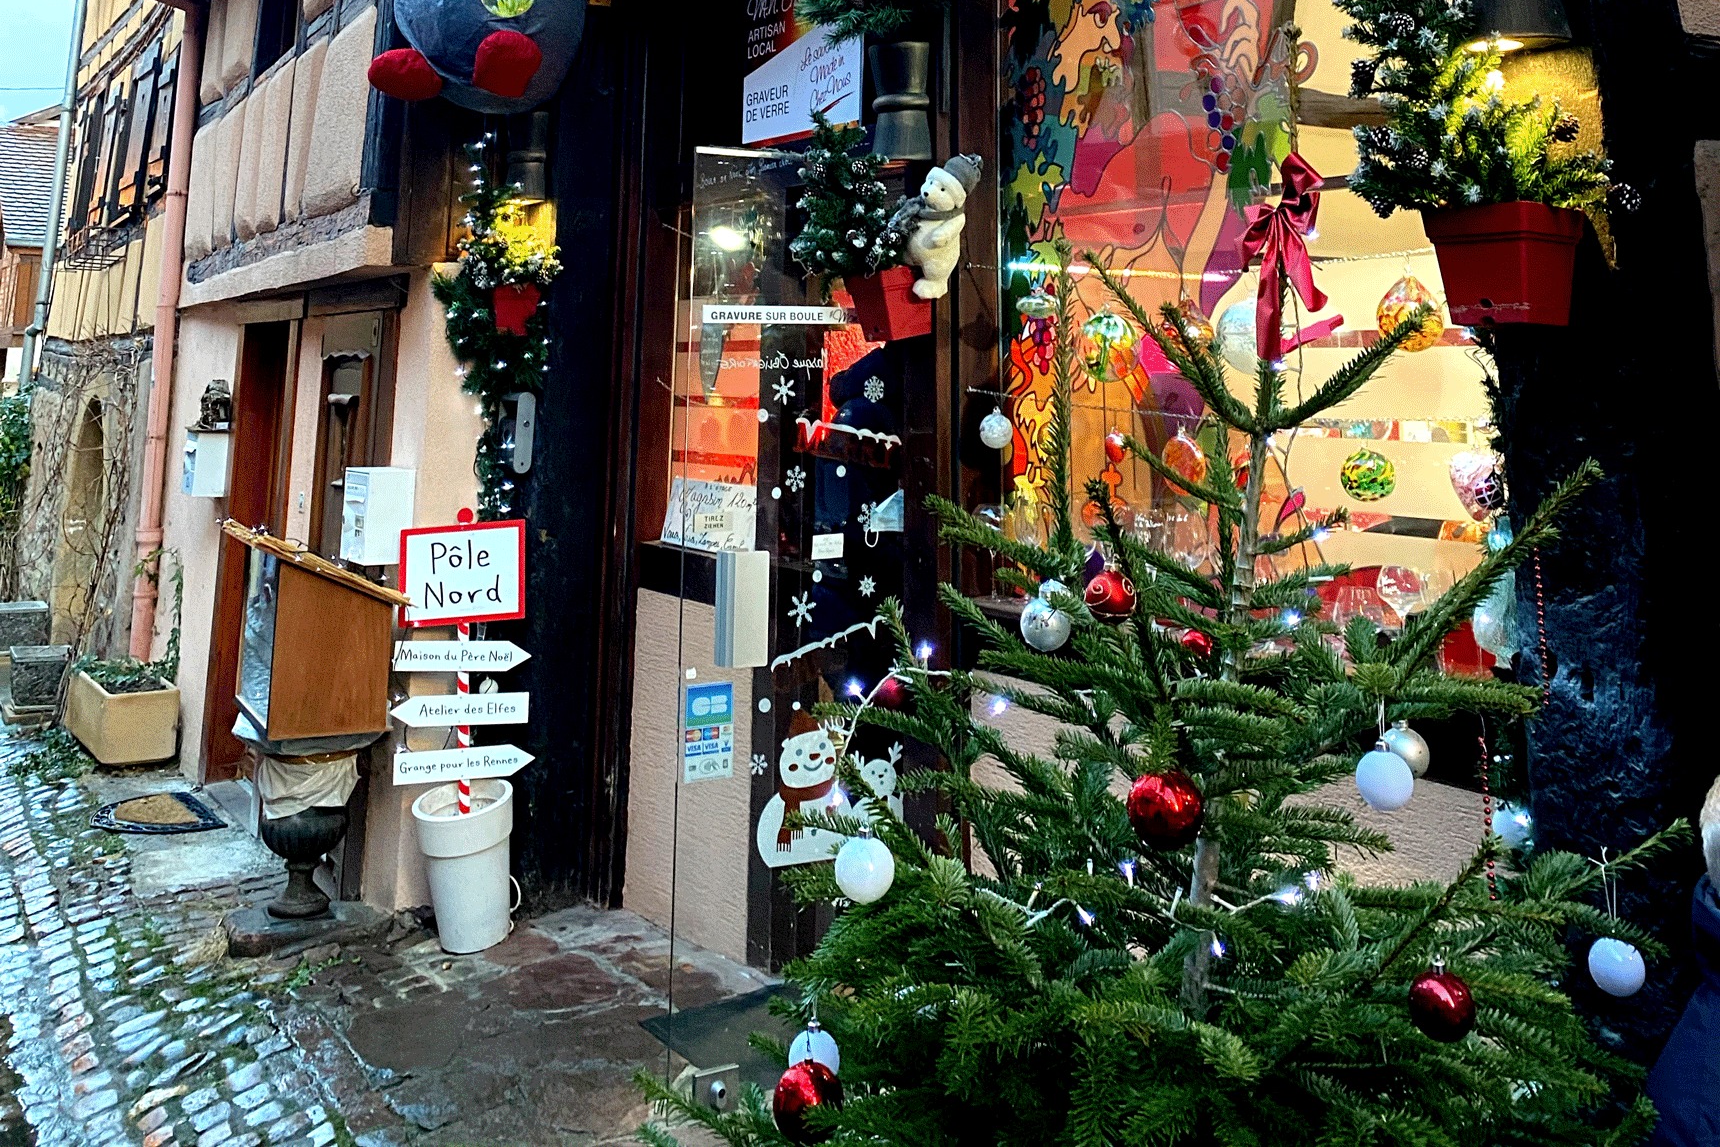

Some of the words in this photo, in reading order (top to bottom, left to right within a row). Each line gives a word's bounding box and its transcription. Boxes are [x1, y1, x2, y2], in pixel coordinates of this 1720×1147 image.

[748, 21, 786, 44] ARTISAN
[748, 40, 777, 60] LOCAL
[746, 84, 789, 107] GRAVEUR
[746, 107, 758, 123] DE
[759, 101, 790, 120] VERRE
[711, 311, 762, 321] GRAVURE
[765, 312, 786, 321] SUR
[790, 312, 823, 321] BOULE
[430, 539, 491, 574] Pôle
[424, 574, 502, 609] Nord
[400, 648, 441, 662] Maison
[444, 648, 457, 661] du
[461, 649, 485, 662] Père
[488, 649, 514, 662] Noël
[419, 703, 460, 716] Atelier
[464, 704, 483, 715] des
[487, 702, 516, 714] Elfes
[692, 695, 727, 716] CB
[687, 744, 701, 752] VISA
[704, 742, 718, 750] VISA
[400, 761, 437, 775] Grange
[440, 761, 464, 772] pour
[467, 758, 480, 768] les
[483, 756, 518, 766] Rennes
